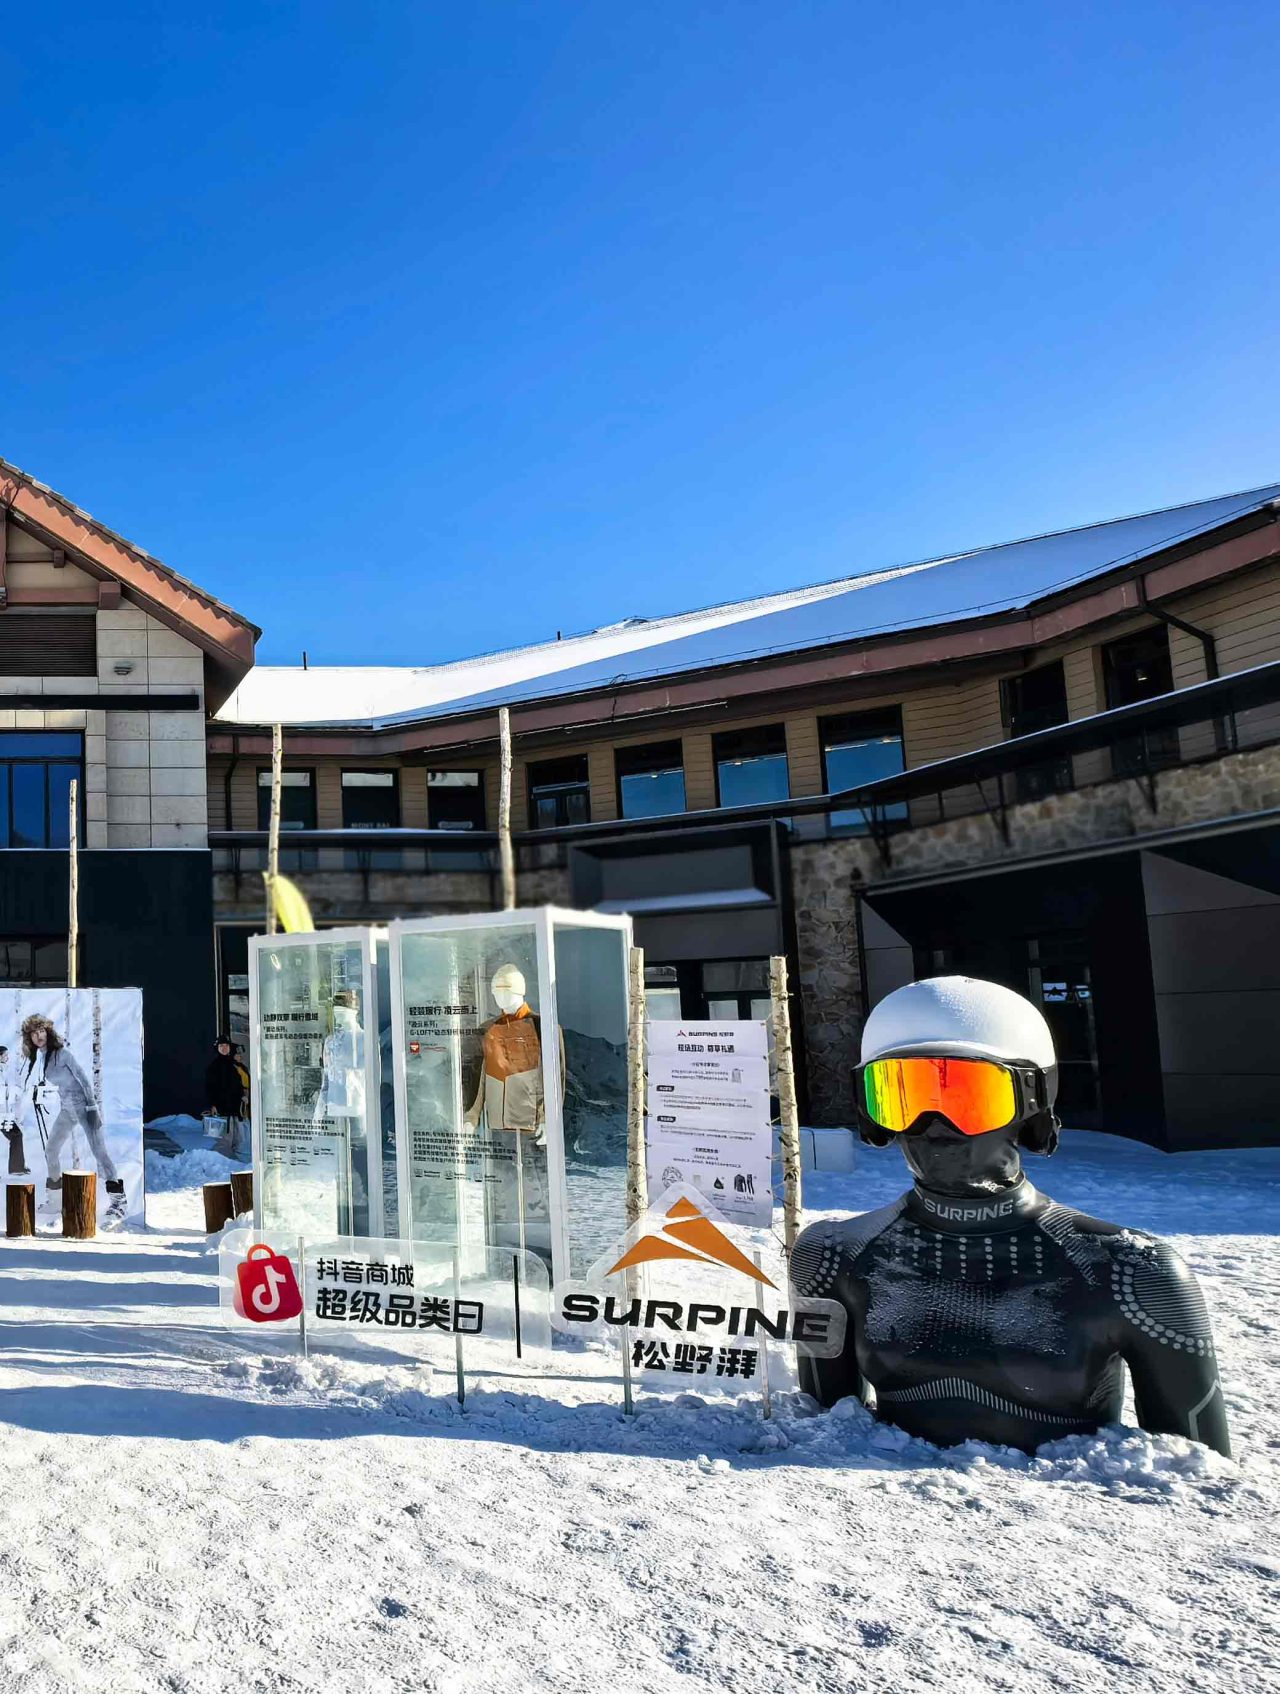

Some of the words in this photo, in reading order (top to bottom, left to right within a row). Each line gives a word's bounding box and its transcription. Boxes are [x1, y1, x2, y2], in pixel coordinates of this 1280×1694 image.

[924, 1198, 1014, 1221] SURPINE
[317, 1258, 414, 1288] 抖音商城
[315, 1287, 484, 1334] 超级品类日
[562, 1294, 831, 1343] SURPINE
[632, 1340, 758, 1379] 松野湃
